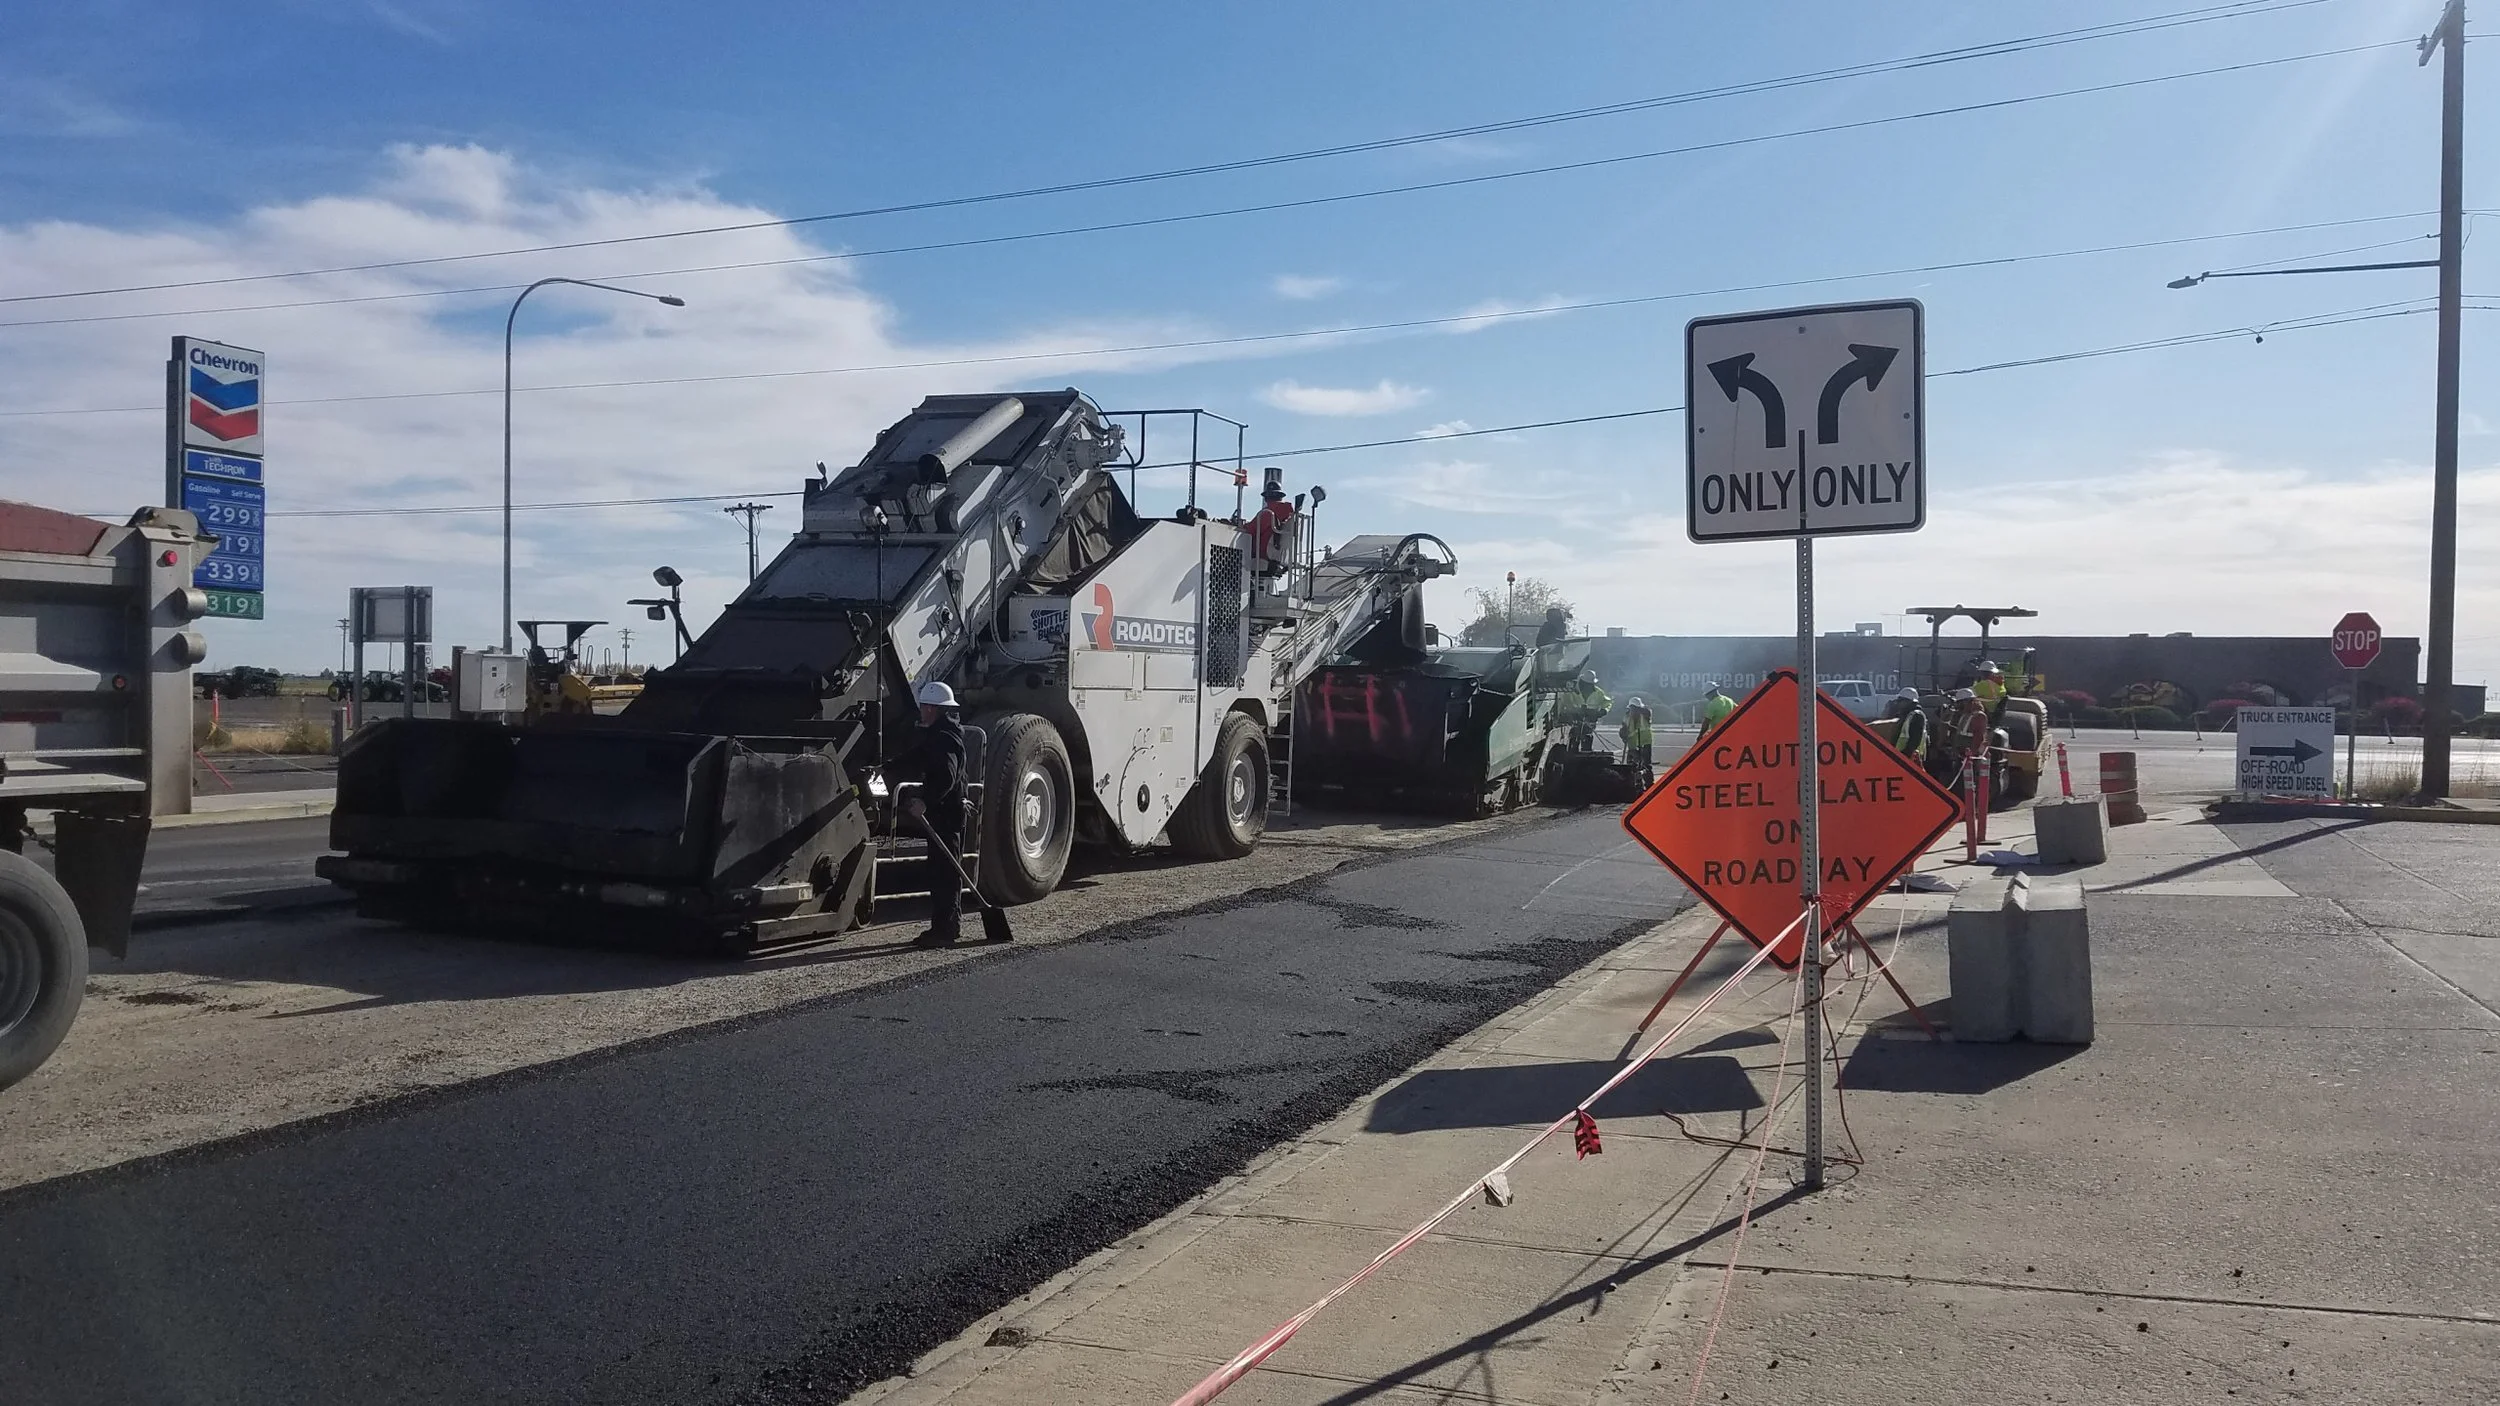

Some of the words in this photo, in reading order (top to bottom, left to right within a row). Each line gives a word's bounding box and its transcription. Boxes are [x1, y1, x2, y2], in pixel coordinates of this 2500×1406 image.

[189, 347, 259, 376] Chevron
[204, 459, 246, 476] TECHRON
[188, 483, 221, 495] Gasoline
[244, 490, 262, 500] Serve
[1702, 469, 1796, 515] ONLY
[1812, 461, 1911, 508] ONLY
[208, 505, 250, 525] 299
[215, 535, 250, 553] 19
[208, 562, 250, 582] 339
[207, 595, 249, 615] 319
[1032, 609, 1069, 631] SHUTTLE
[1116, 620, 1197, 646] ROADTEC
[2335, 630, 2377, 651] STOP
[2240, 711, 2275, 724] TRUCK
[2277, 711, 2332, 724] ENTRANCE
[1713, 740, 1862, 771] CAUTON
[2240, 759, 2306, 775] OFF-ROAD
[2241, 775, 2264, 790] HIGH
[2265, 775, 2294, 790] SPEED
[2296, 776, 2327, 791] DIESEL
[1675, 781, 1775, 811] STEEL
[1797, 776, 1906, 804] LATE
[1703, 856, 1876, 886] ROADAY
